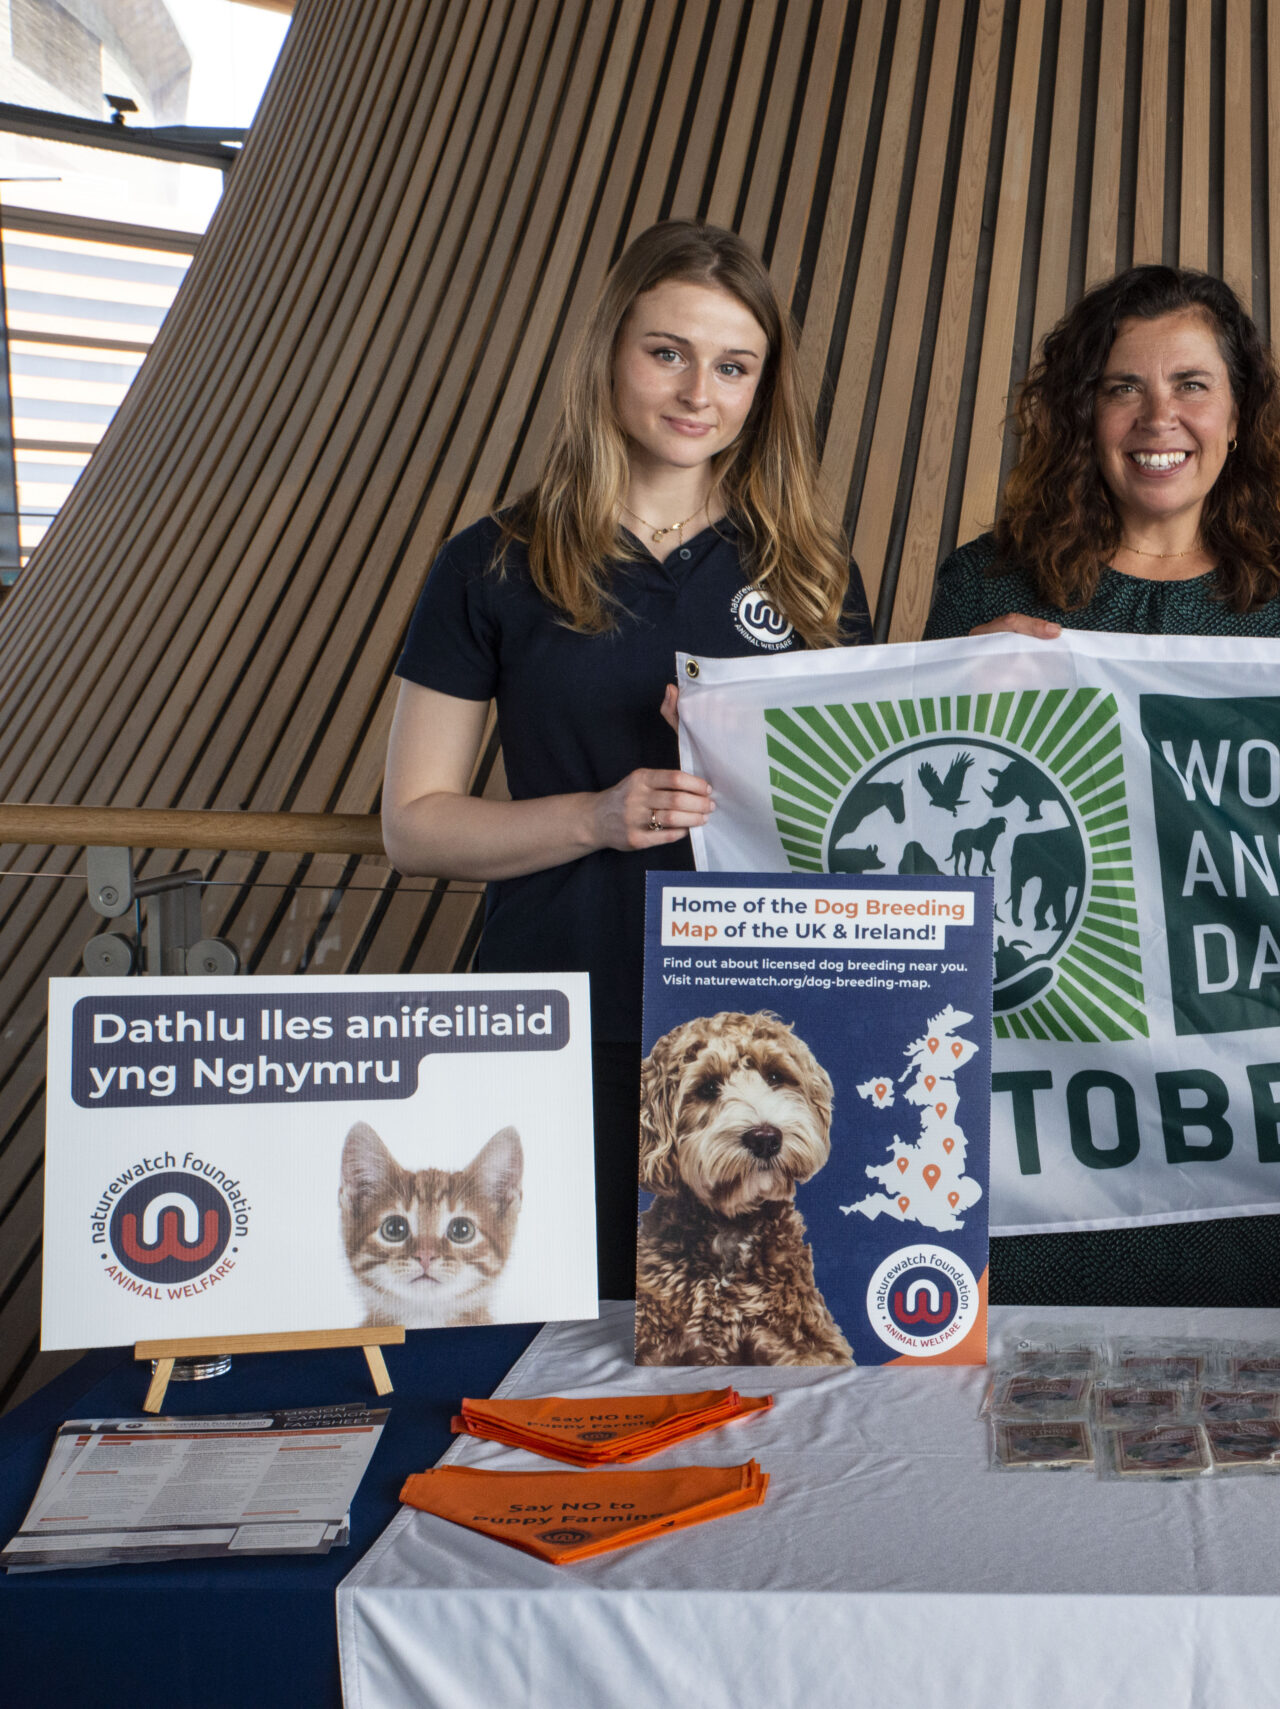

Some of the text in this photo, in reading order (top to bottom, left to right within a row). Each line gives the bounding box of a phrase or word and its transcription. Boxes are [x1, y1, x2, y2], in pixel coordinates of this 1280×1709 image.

[735, 623, 793, 652] ANIMAL WELFARE
[672, 896, 965, 921] Home of the Dog Breeding
[671, 921, 937, 941] Map of the UK & Ireland!
[663, 957, 968, 975] Find out about licensed dog breeding near you.
[663, 974, 931, 989] Visit naturewatch.org/dog-breeding-map.
[92, 1005, 553, 1044] Dathlu lles anifeiliaid
[89, 1055, 401, 1099] yng Nghymru
[90, 1151, 252, 1244] naturewatch foundation
[104, 1257, 236, 1300] ANIMAL WELFARE
[876, 1253, 970, 1310] naturewatch foundation
[884, 1322, 961, 1347] ANIMAL WELFARE
[283, 1417, 373, 1428] FACTSHEET
[286, 1411, 370, 1422] CAMPAIGN
[509, 1503, 553, 1512] Say
[562, 1502, 601, 1510] NO
